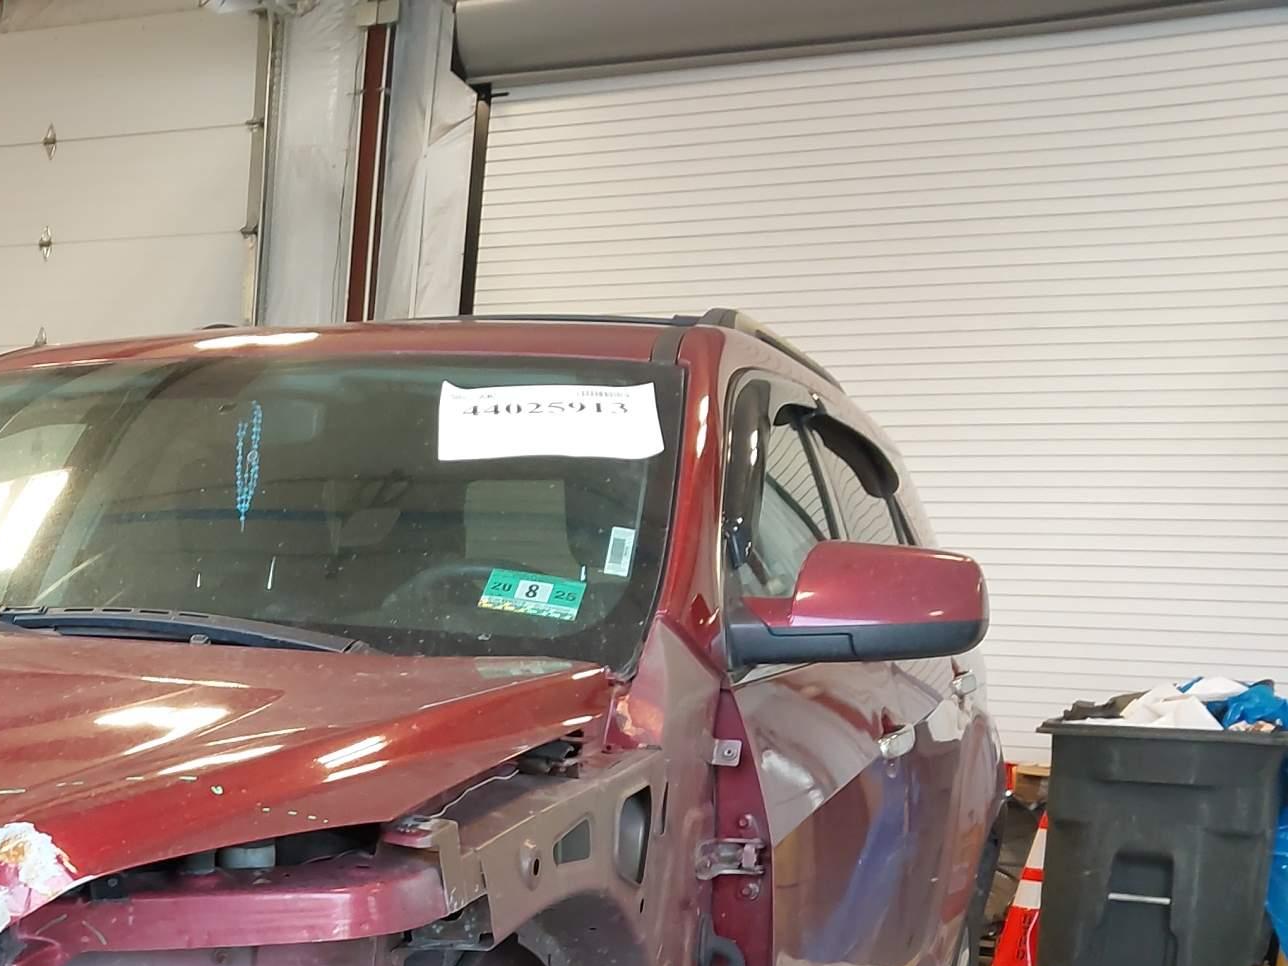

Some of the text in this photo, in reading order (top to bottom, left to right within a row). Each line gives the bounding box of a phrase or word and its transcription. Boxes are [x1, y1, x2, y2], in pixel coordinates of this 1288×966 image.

[462, 402, 628, 416] 44025913
[491, 583, 512, 593] 20
[525, 584, 540, 598] 8
